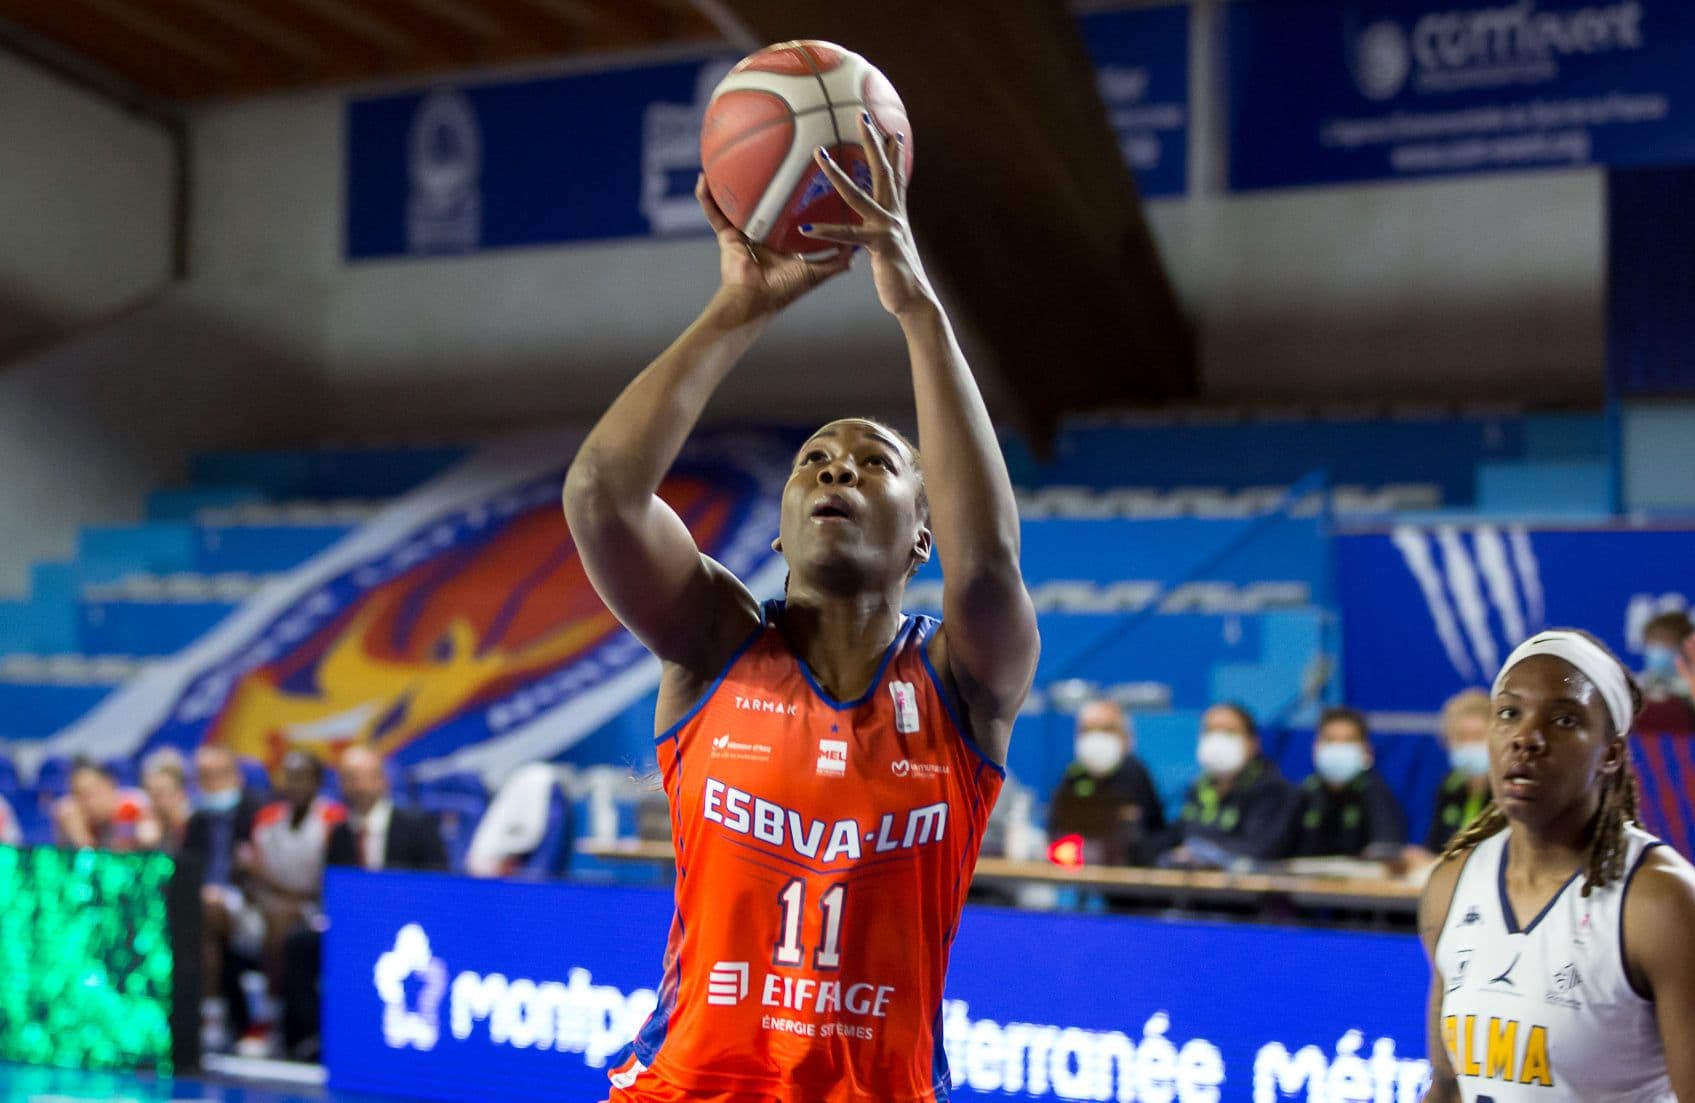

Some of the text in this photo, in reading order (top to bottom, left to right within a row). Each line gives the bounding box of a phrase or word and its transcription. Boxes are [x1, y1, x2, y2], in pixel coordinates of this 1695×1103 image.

[735, 696, 797, 716] TARMAK
[703, 777, 949, 864] ESBVA-LM
[772, 876, 849, 973] 11
[761, 1015, 816, 1037] ÉNERGIE
[942, 998, 1226, 1103] terranée
